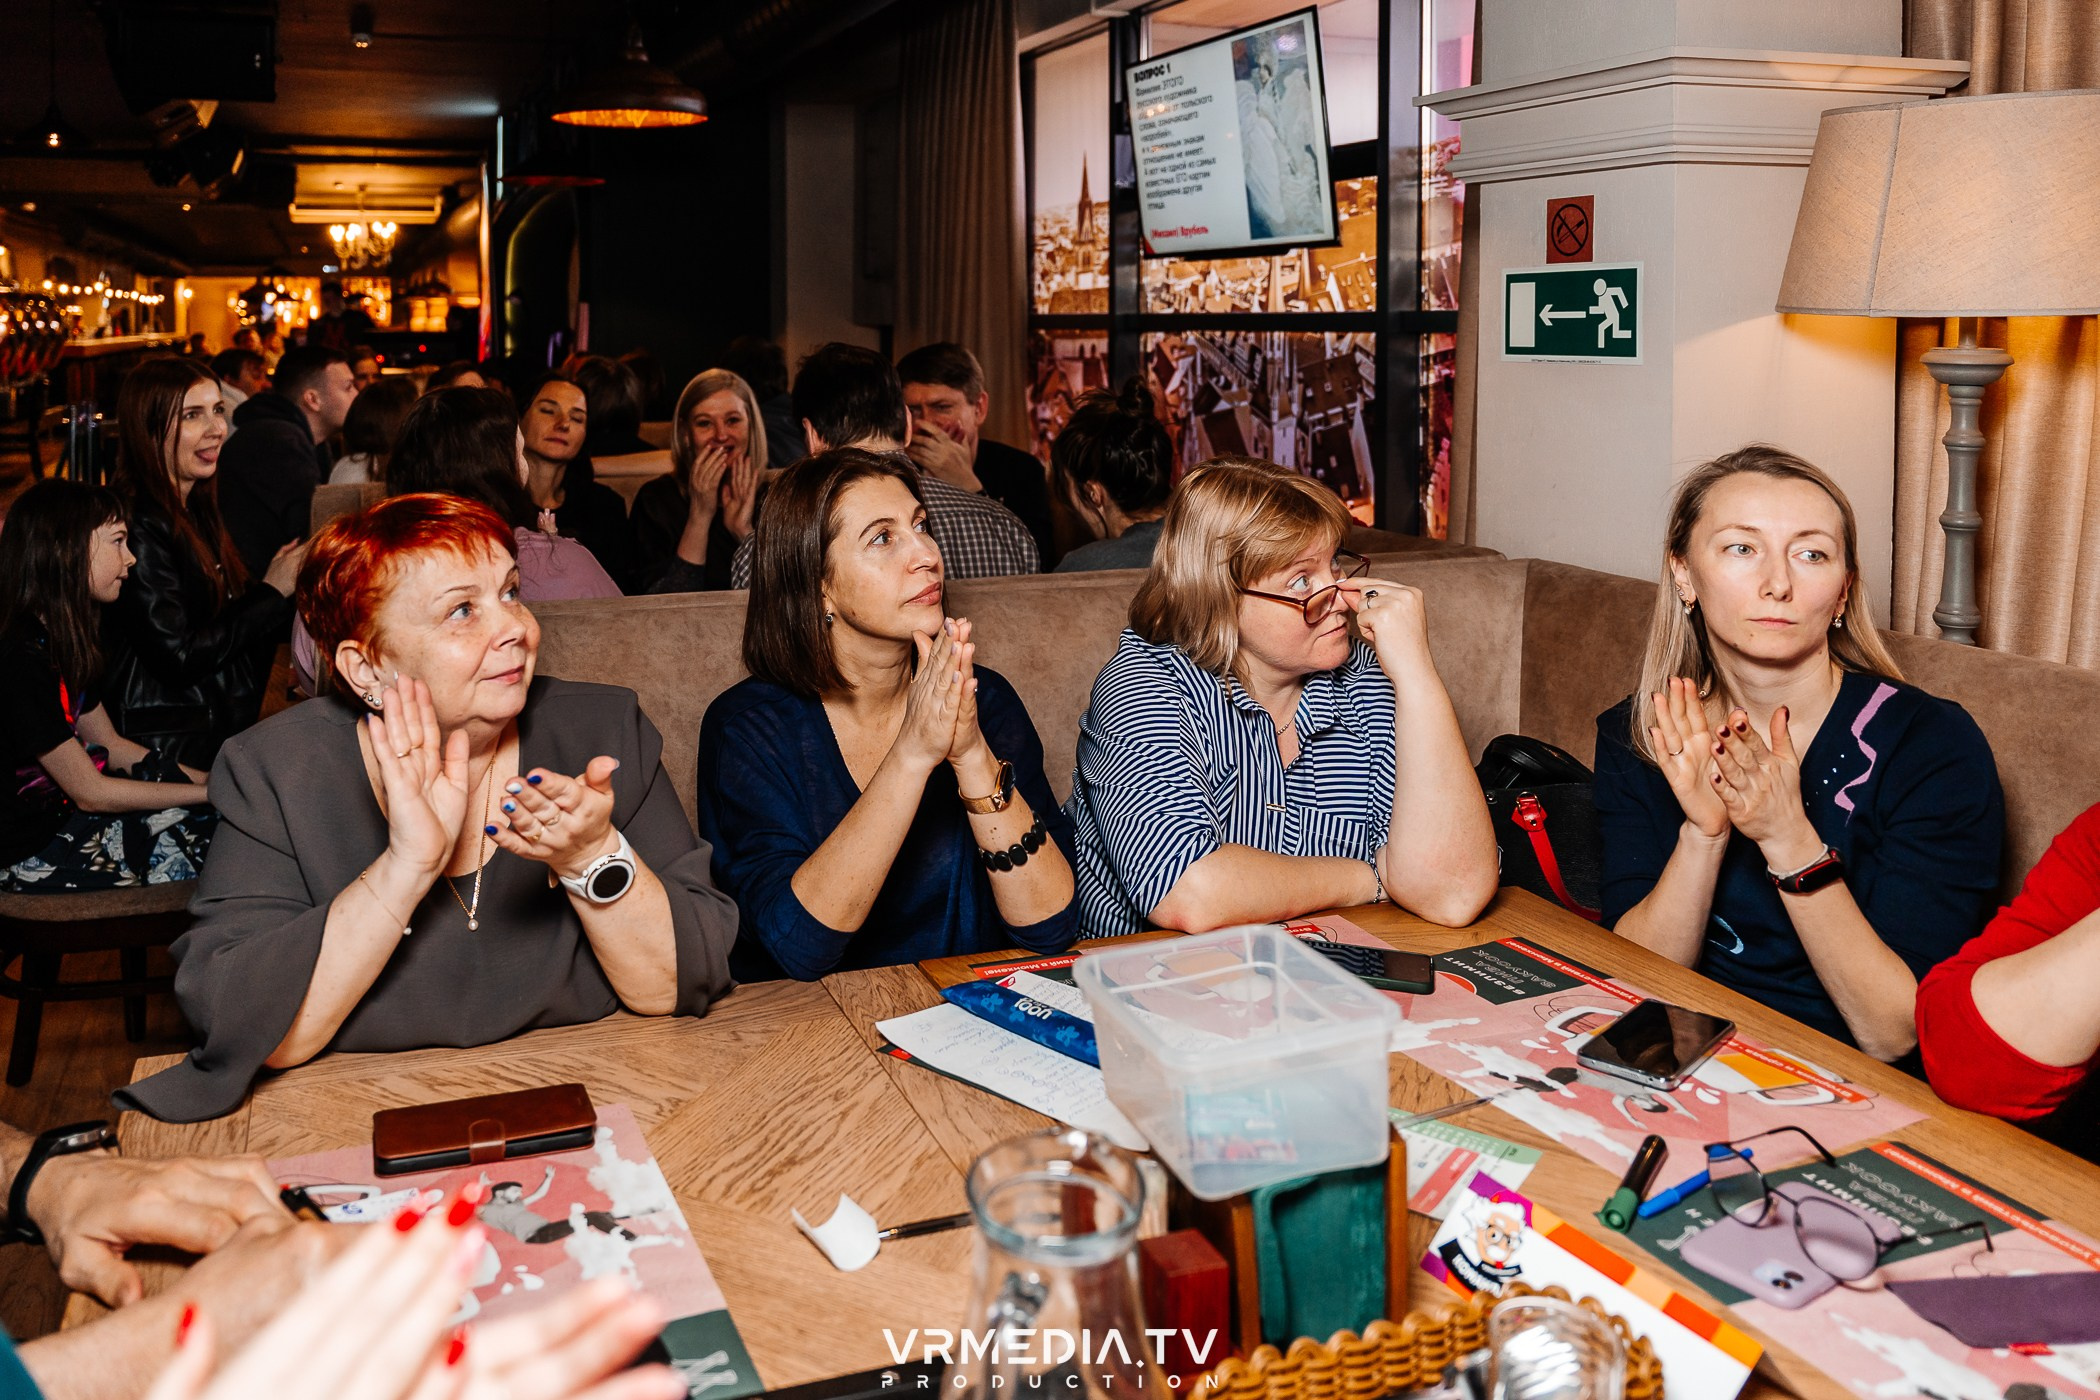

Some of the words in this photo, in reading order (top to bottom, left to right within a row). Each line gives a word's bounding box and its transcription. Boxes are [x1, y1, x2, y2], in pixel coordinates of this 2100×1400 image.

[1134, 64, 1165, 83] ВОПРОС
[1166, 62, 1171, 74] 1
[1162, 76, 1184, 90] ЭТОГО
[1164, 87, 1197, 102] художника
[1181, 95, 1213, 108] польского
[1158, 111, 1199, 126] означающего
[1183, 134, 1205, 144] знакам
[1143, 154, 1174, 165] отношения
[1168, 161, 1187, 172] одной
[1196, 158, 1216, 167] самых
[1145, 177, 1174, 188] известных
[1175, 172, 1188, 183] ЕГО
[1189, 171, 1210, 181] картин
[1146, 188, 1181, 199] изображена
[1182, 185, 1203, 196] другая
[1181, 224, 1209, 238] Врубель
[984, 964, 1041, 976] Мюнхене!
[1443, 957, 1526, 995] БЕЗЛИМИТ
[1472, 949, 1556, 989] ЗАКУСОК
[1475, 960, 1525, 985] ПИВА
[1560, 965, 1635, 1001] удовольствий
[1849, 1180, 1926, 1224] ПИВА
